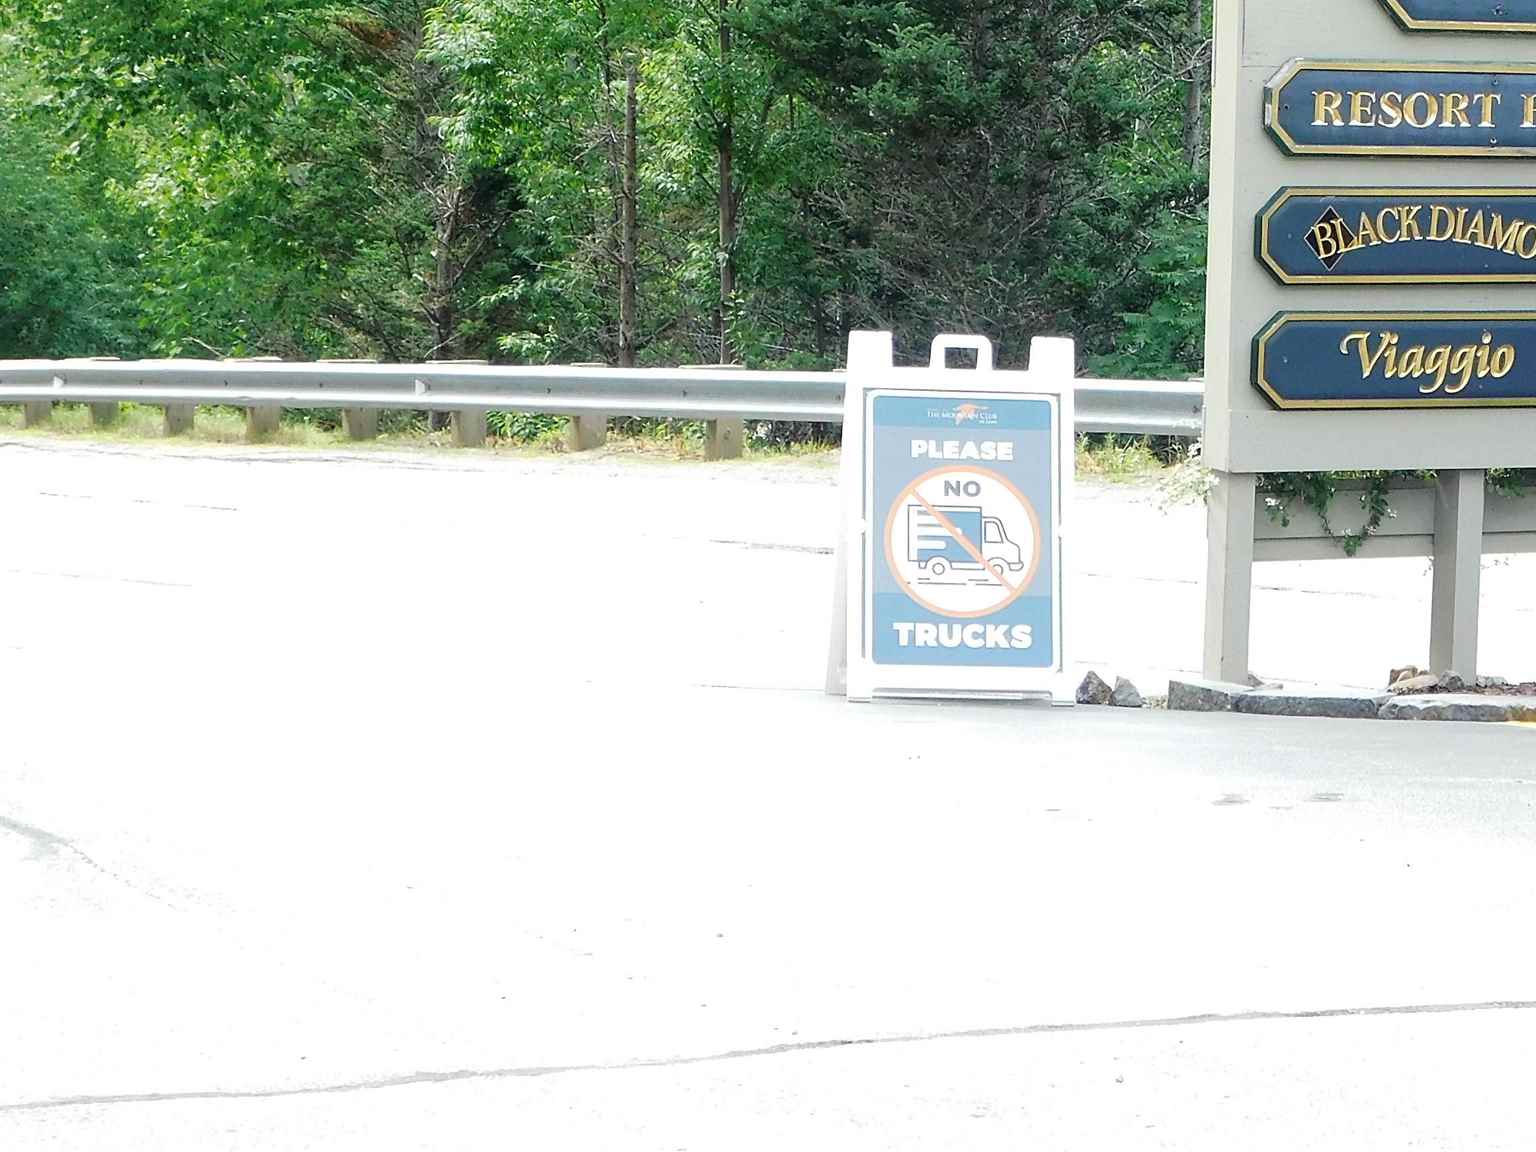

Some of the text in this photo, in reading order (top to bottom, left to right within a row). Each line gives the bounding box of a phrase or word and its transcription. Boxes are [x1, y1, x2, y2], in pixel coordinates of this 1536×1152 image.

[1311, 91, 1501, 128] RESORT
[1311, 205, 1424, 260] BLACK
[1339, 332, 1515, 394] Viaggio
[911, 439, 1014, 460] PLEASE
[944, 480, 981, 497] NO
[893, 622, 1033, 649] TRUCKS
